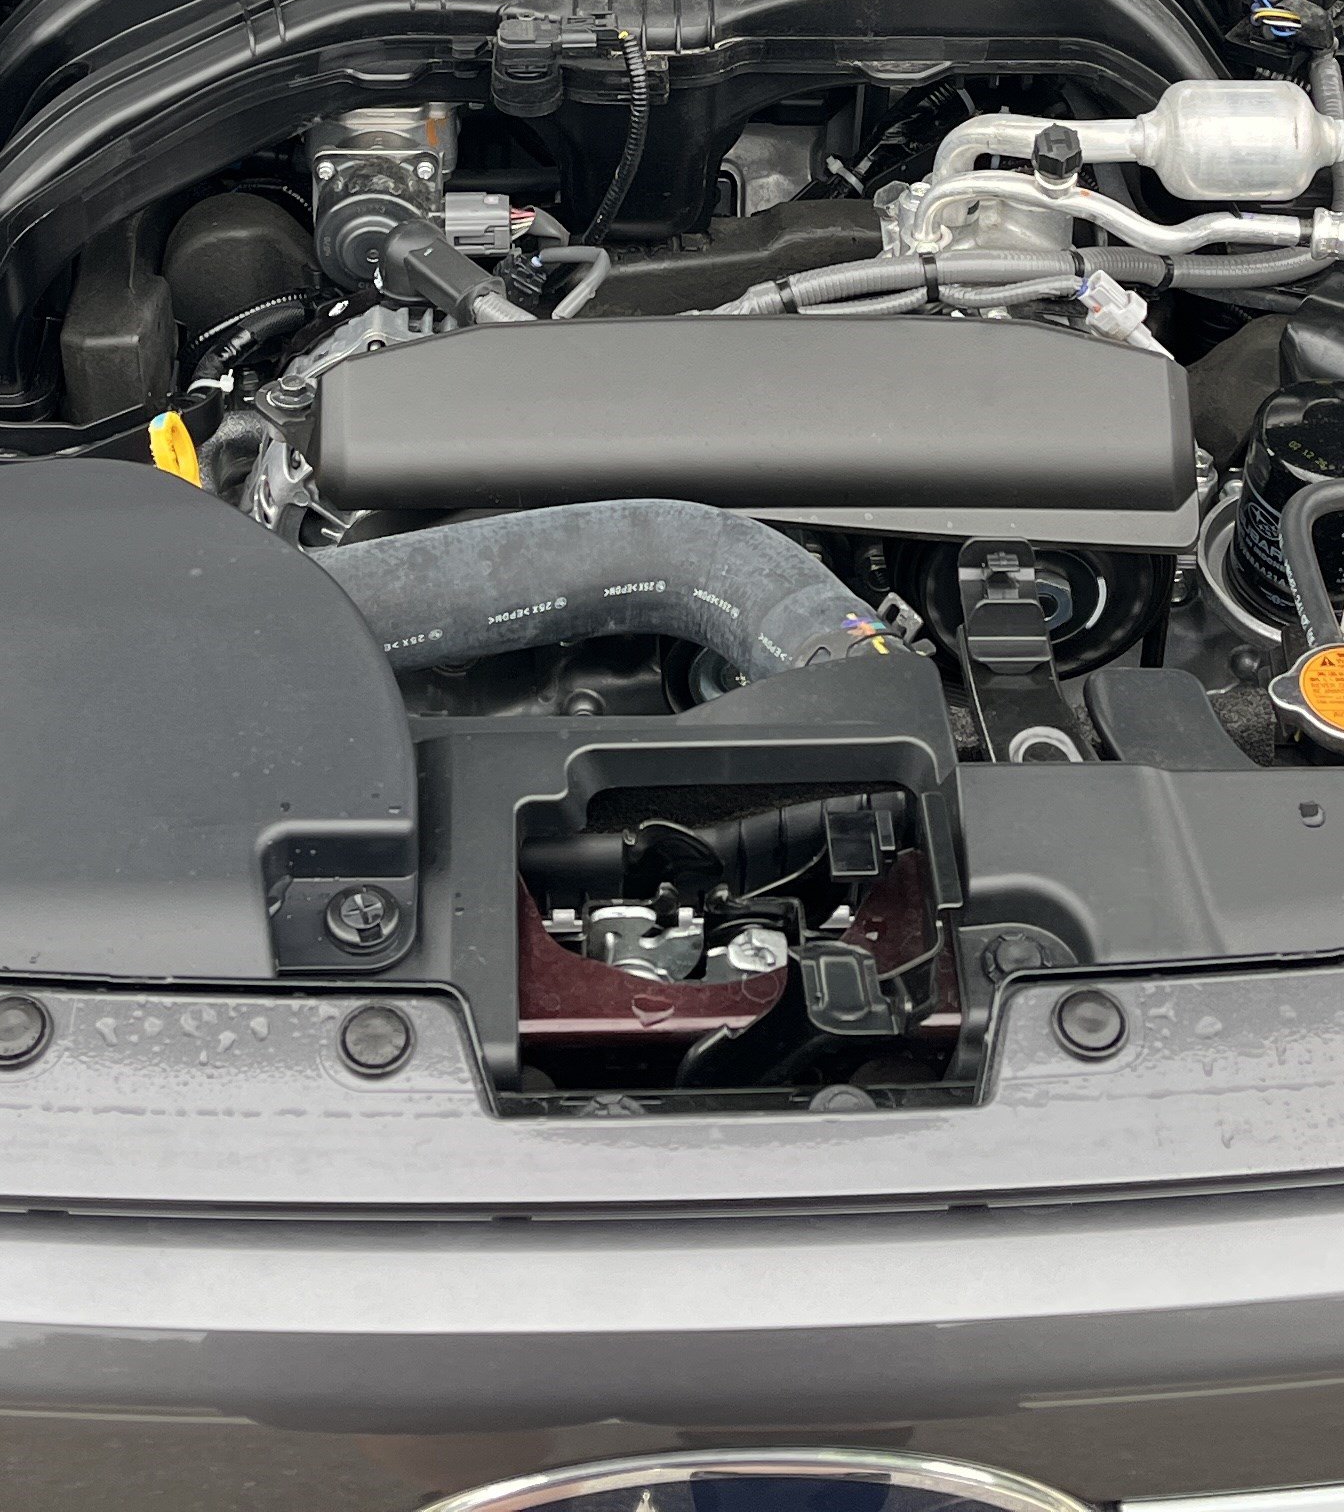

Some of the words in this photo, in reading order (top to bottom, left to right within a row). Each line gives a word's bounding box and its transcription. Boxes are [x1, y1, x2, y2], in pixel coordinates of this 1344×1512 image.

[1044, 130, 1072, 152] H
[532, 601, 552, 615] 25X
[401, 633, 425, 648] 25X
